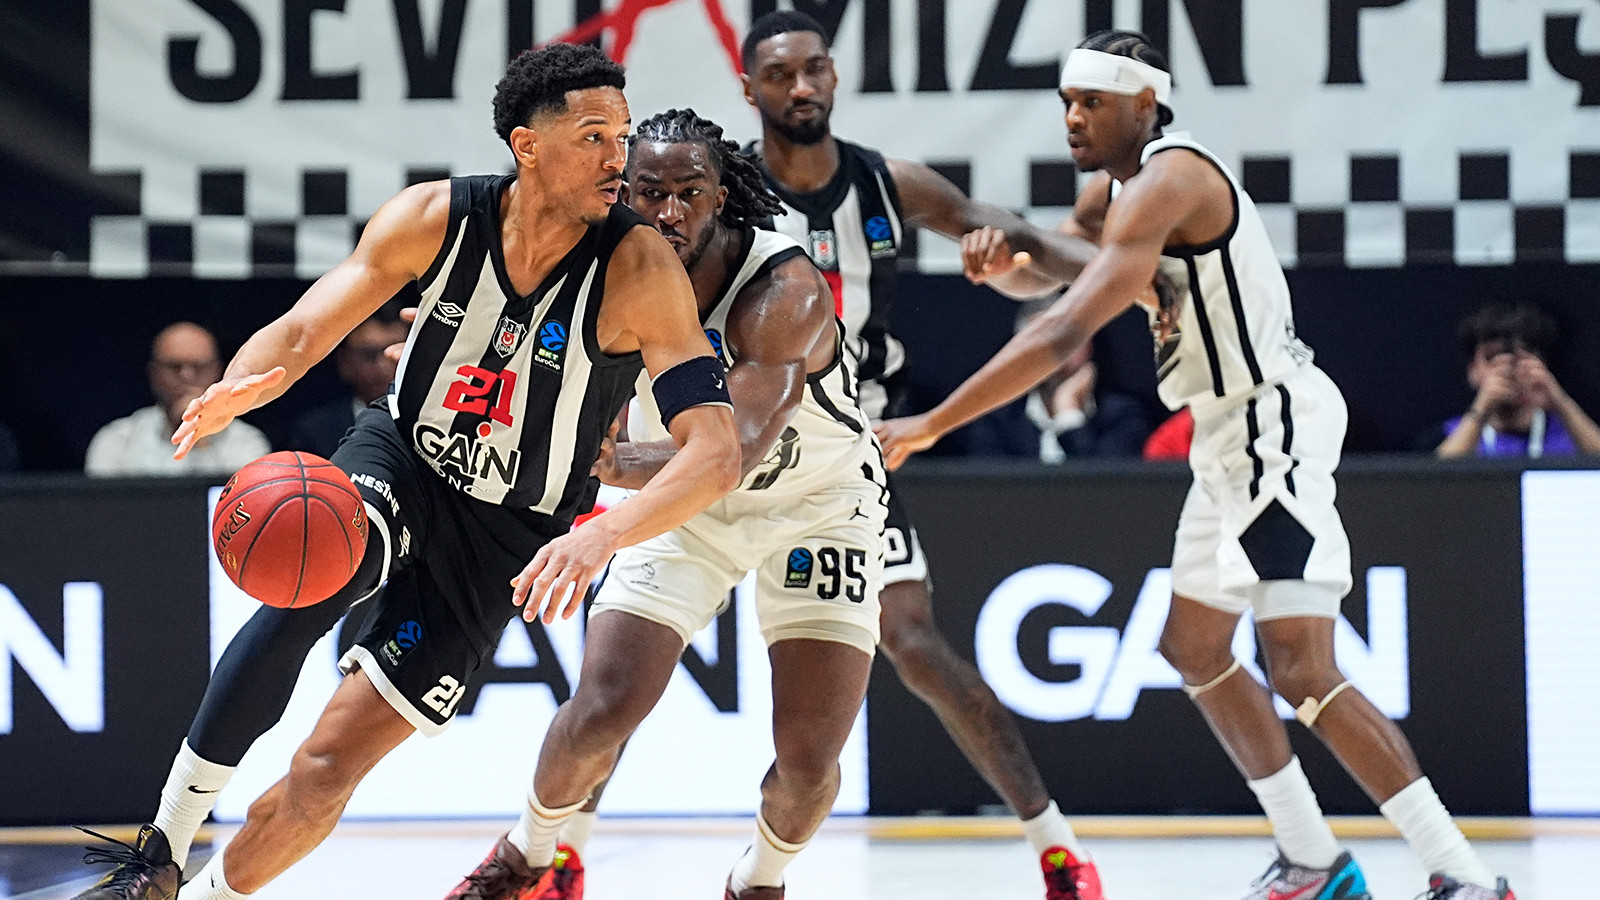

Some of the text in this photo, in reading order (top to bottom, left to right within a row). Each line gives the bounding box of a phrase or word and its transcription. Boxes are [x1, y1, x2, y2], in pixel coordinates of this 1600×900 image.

[432, 310, 459, 328] umbro
[534, 355, 561, 371] EuroCup
[442, 364, 518, 428] 21
[817, 547, 866, 603] 95
[421, 675, 466, 718] 21
